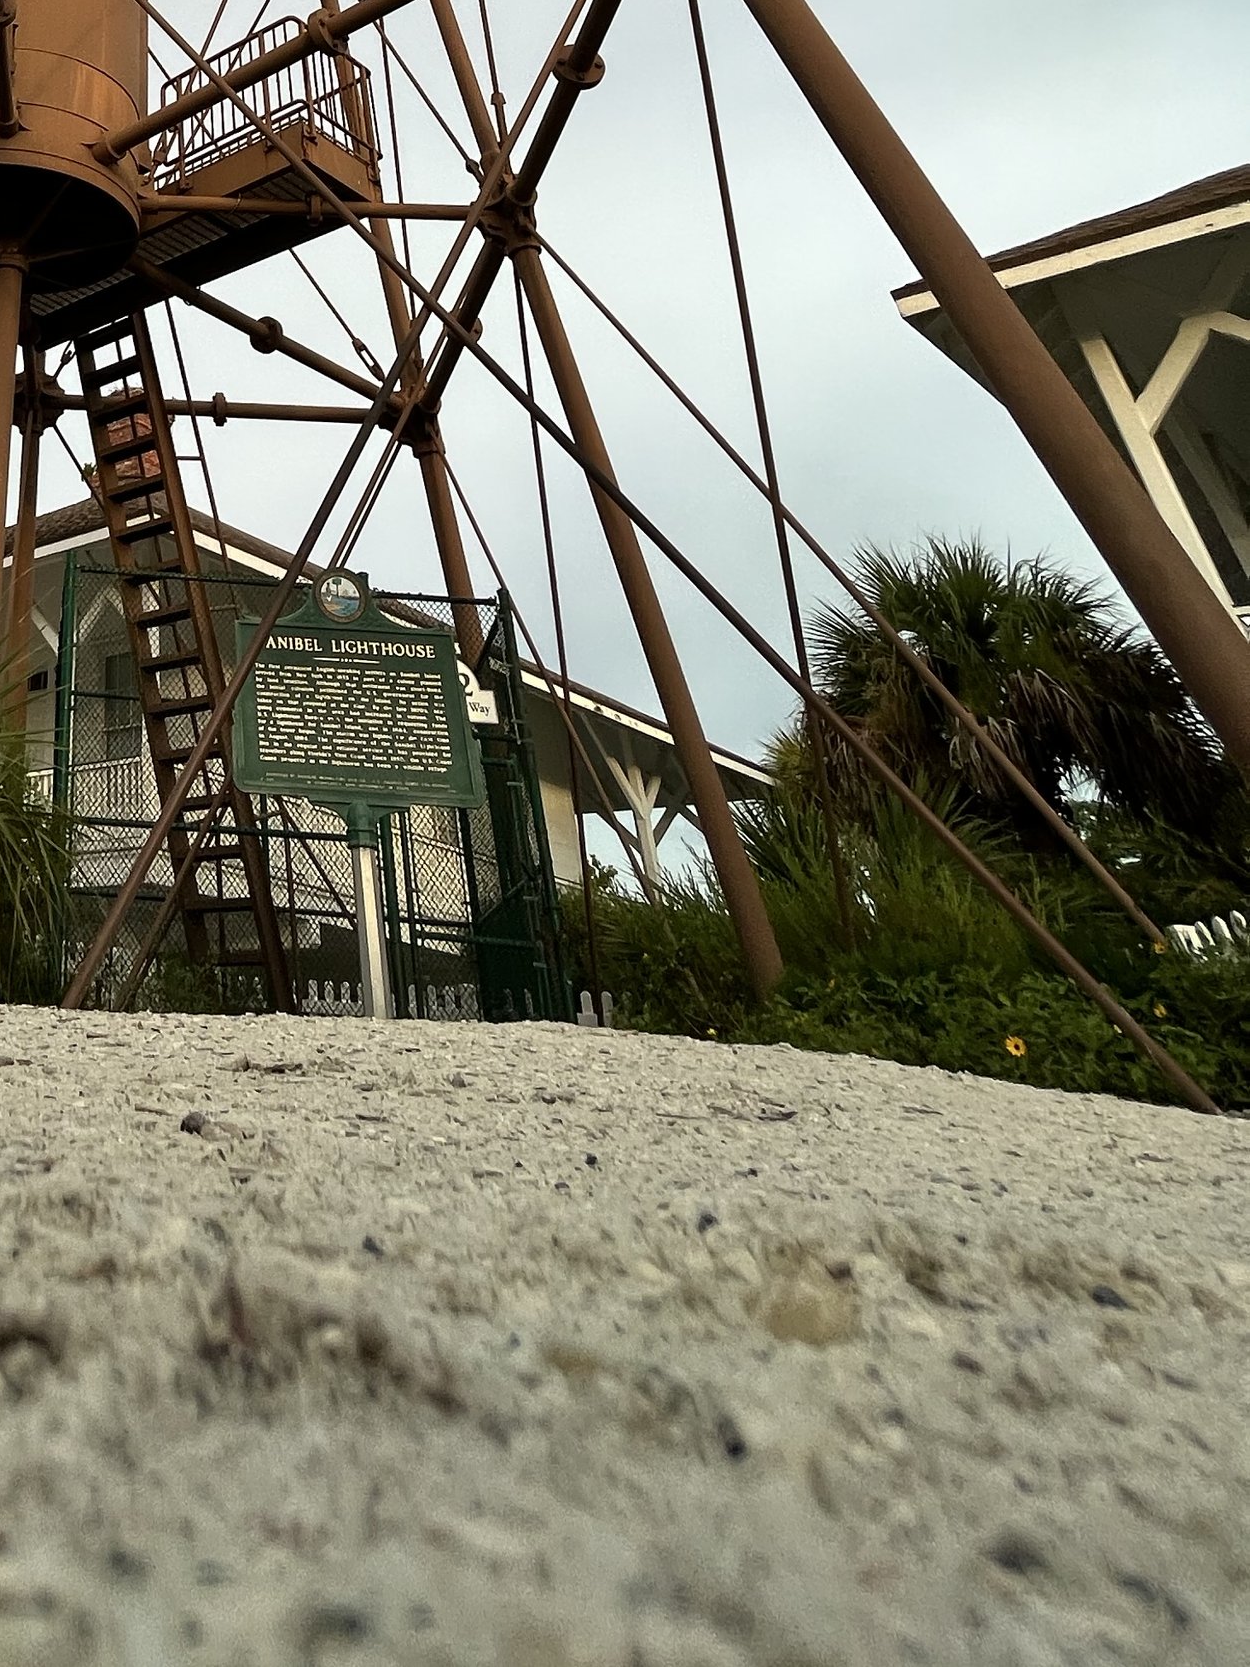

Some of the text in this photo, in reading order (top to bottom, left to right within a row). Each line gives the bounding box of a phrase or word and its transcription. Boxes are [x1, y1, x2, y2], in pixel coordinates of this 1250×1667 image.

[265, 635, 436, 659] ANIBEL LIGHTHOUSE
[468, 701, 490, 717] Way
